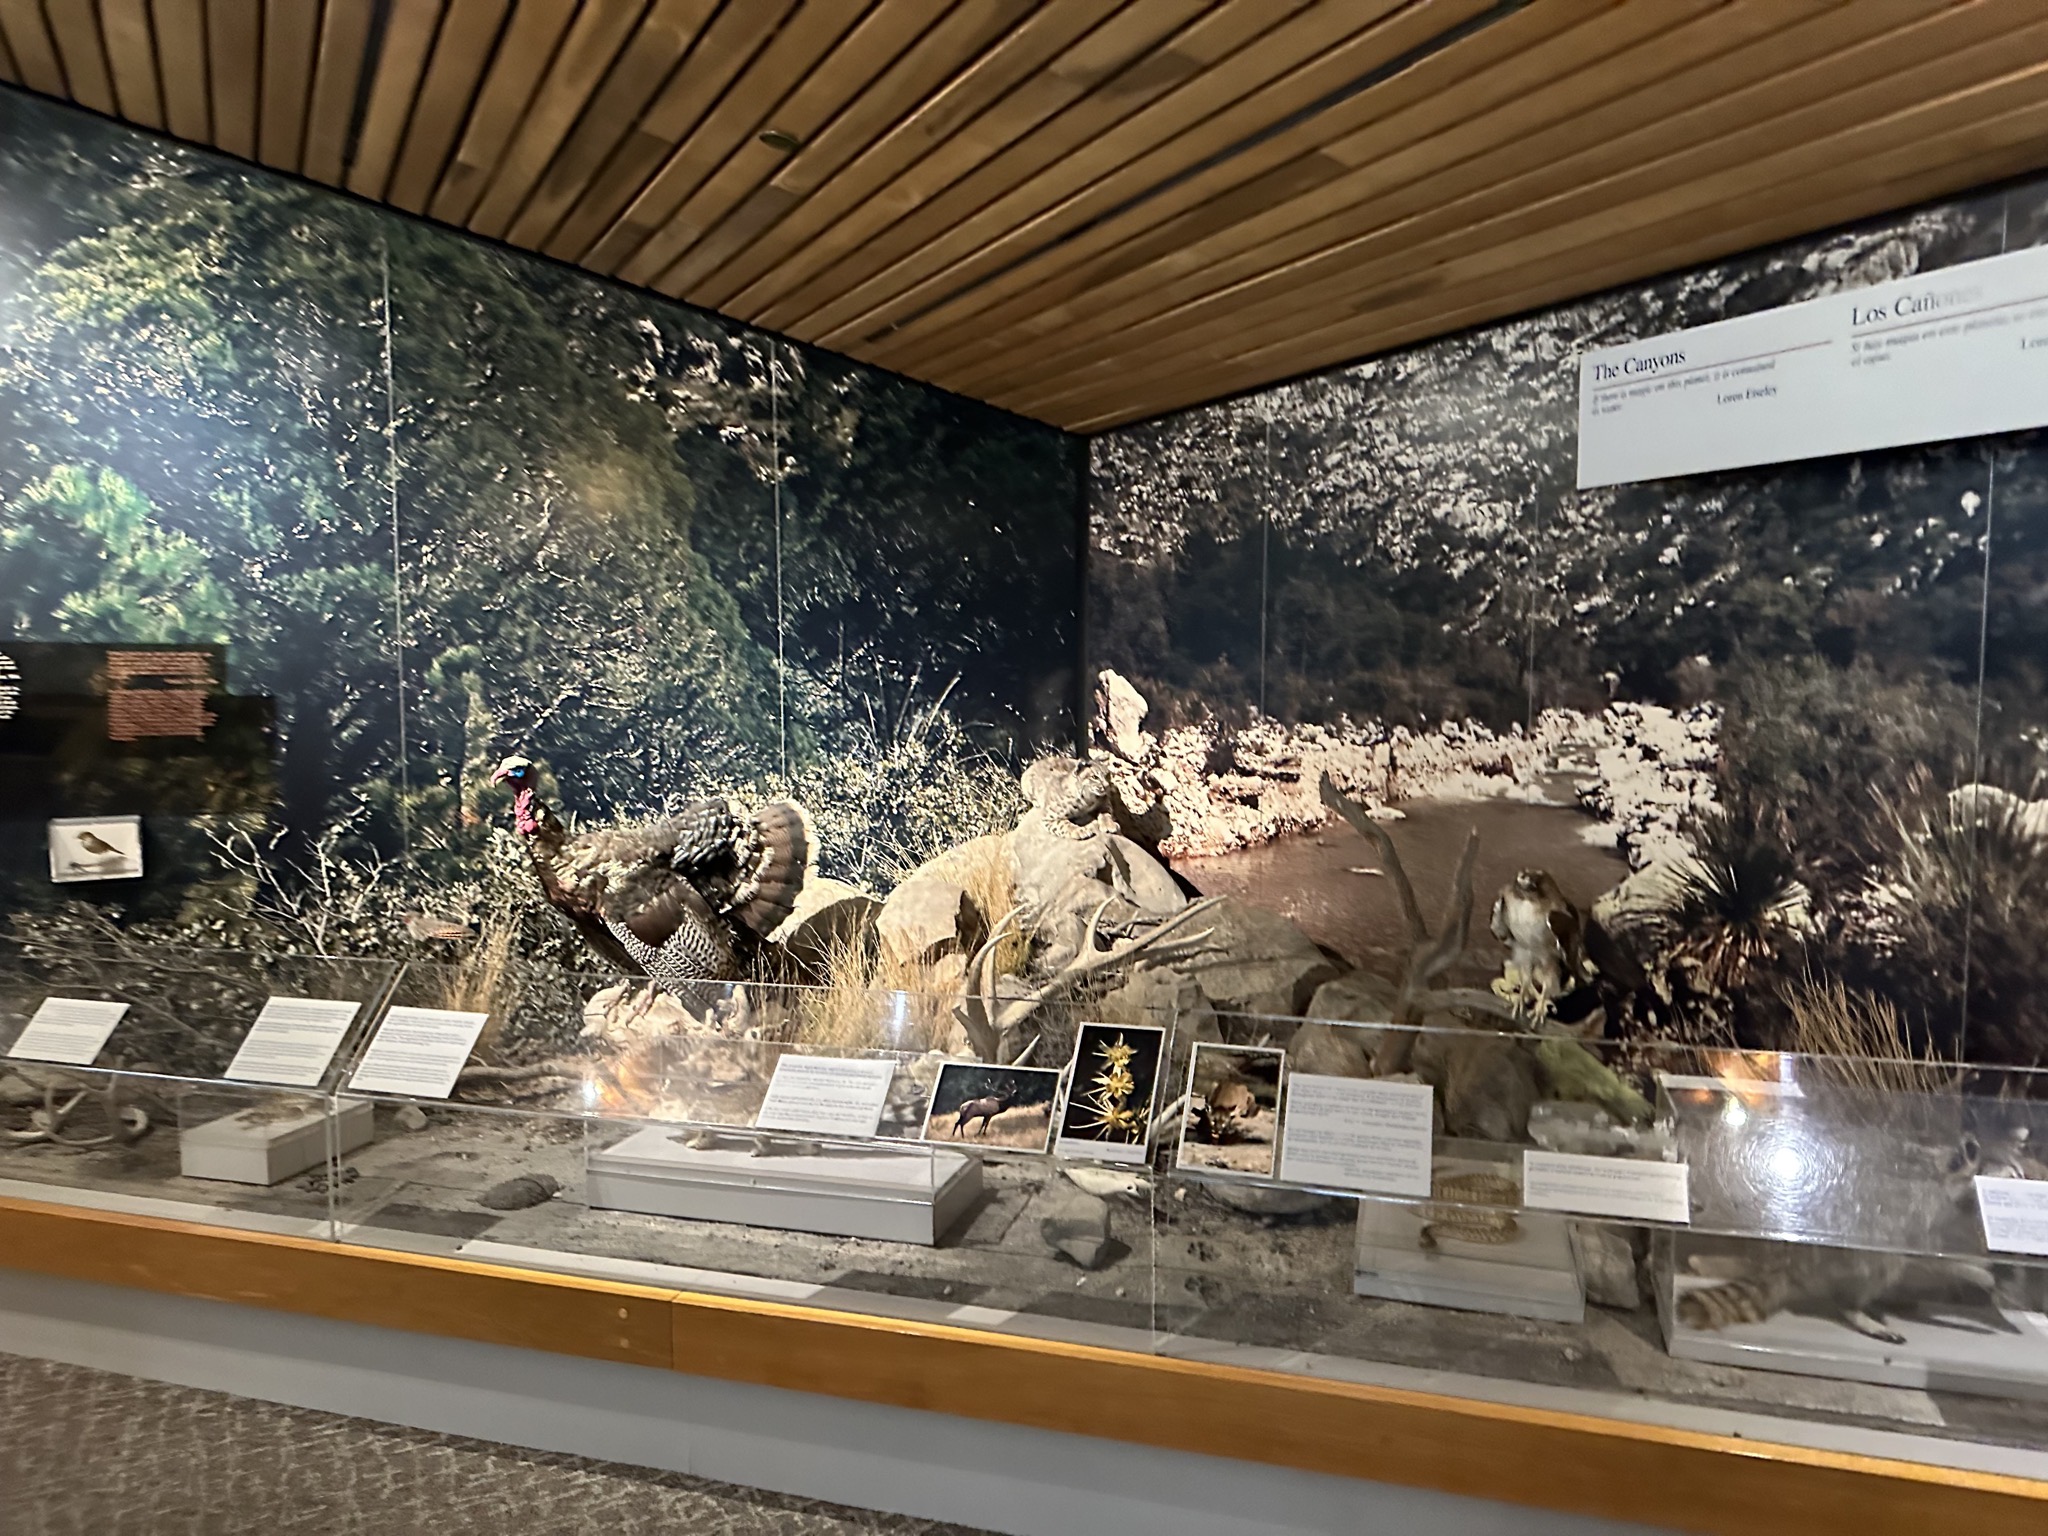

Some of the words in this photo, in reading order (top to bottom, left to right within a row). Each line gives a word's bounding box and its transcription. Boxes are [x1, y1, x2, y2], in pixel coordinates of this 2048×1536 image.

[1852, 305, 1887, 326] Los
[1593, 362, 1619, 380] The
[1623, 352, 1685, 375] Canyons
